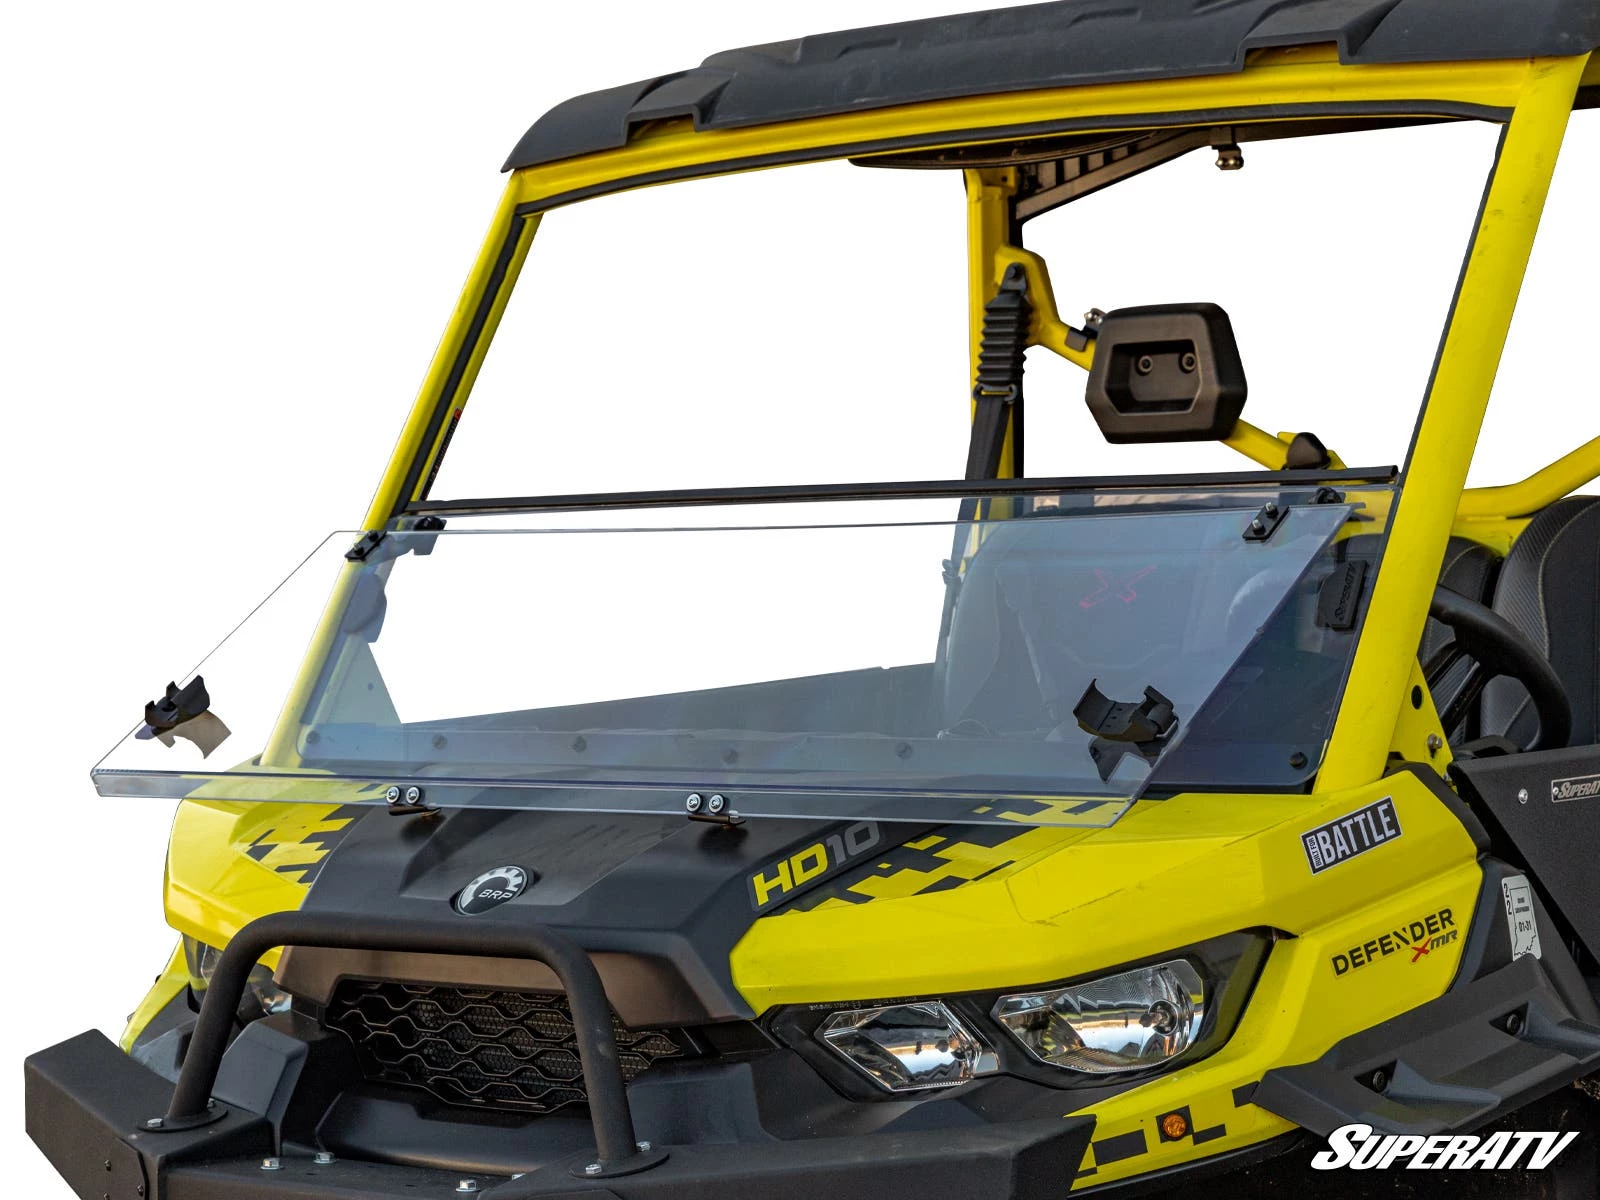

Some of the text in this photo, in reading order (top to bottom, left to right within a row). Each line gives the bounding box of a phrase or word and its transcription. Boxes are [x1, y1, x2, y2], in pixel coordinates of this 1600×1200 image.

[753, 820, 880, 906] HD10
[1308, 837, 1317, 850] FOR
[1316, 803, 1396, 864] BATTLE
[478, 889, 514, 900] BRP
[1332, 908, 1455, 976] DEFENDER
